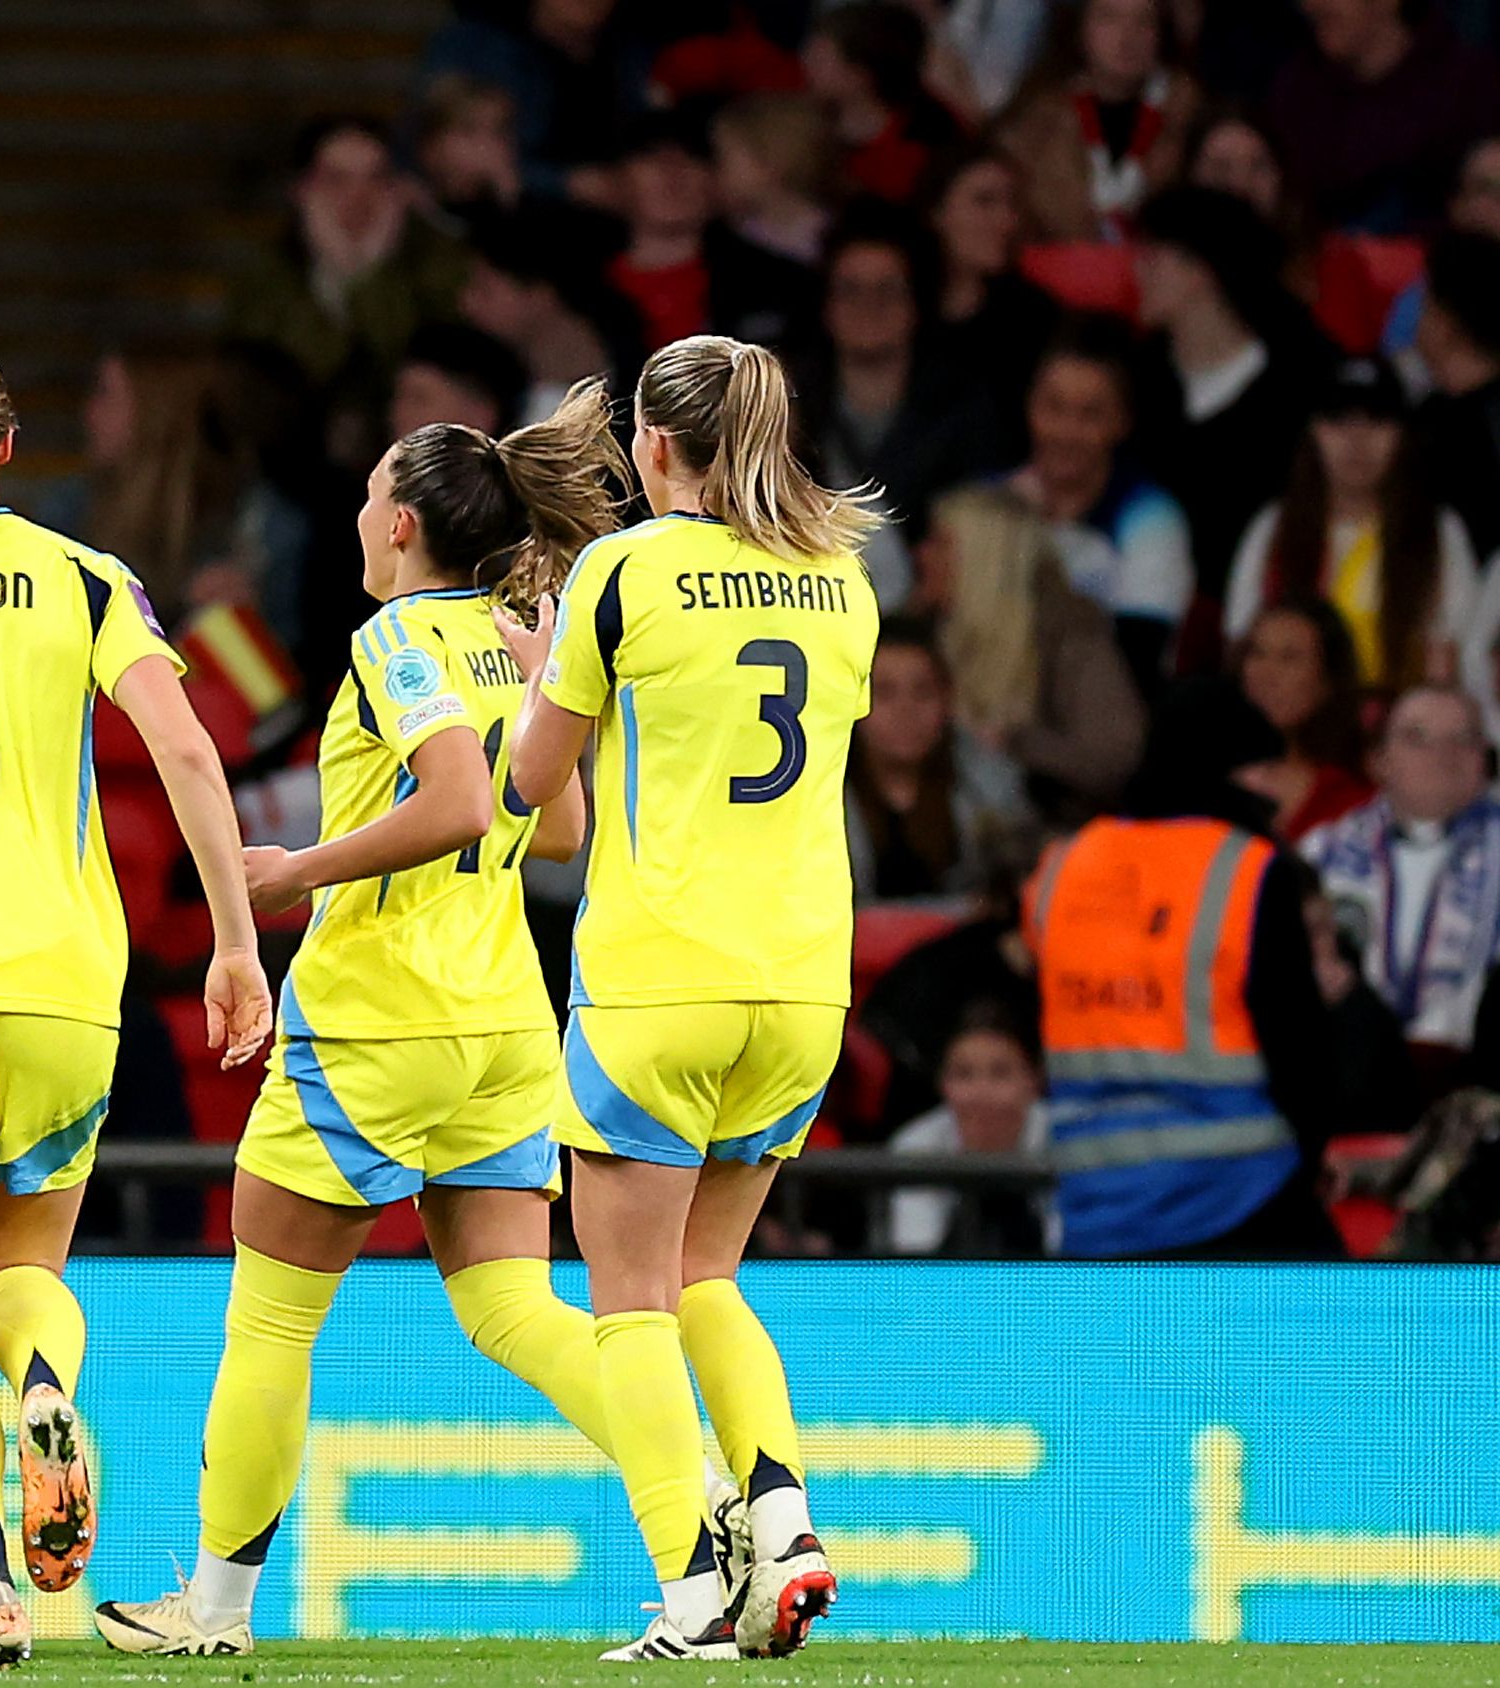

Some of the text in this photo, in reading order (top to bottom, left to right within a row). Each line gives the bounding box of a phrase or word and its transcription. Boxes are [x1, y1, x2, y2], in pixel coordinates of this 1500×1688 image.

[676, 571, 847, 613] SEMBRANT
[464, 648, 527, 686] KAN
[729, 638, 808, 803] 3
